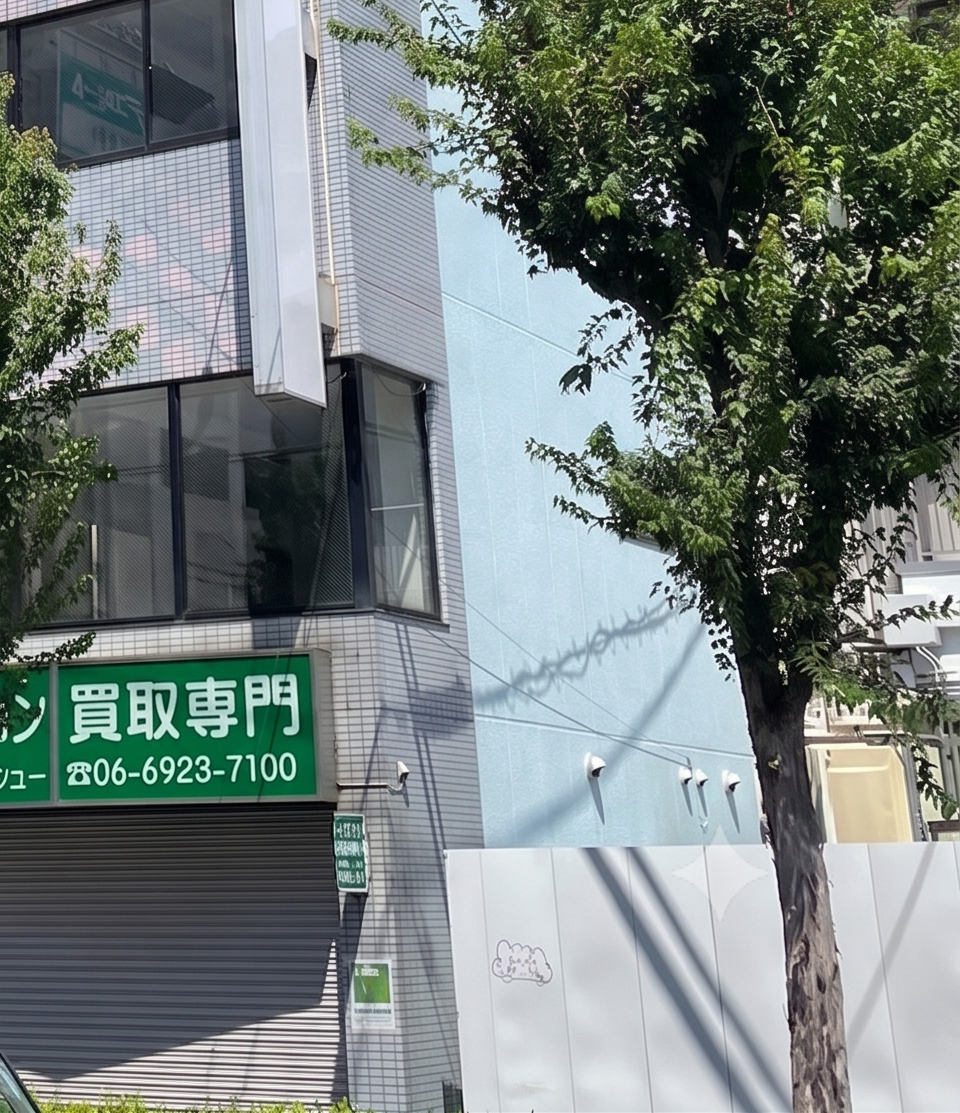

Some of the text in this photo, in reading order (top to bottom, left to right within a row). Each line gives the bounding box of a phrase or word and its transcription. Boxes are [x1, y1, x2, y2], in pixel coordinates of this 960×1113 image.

[69, 673, 300, 745] 買取専門
[93, 752, 297, 787] 06-6923-7100
